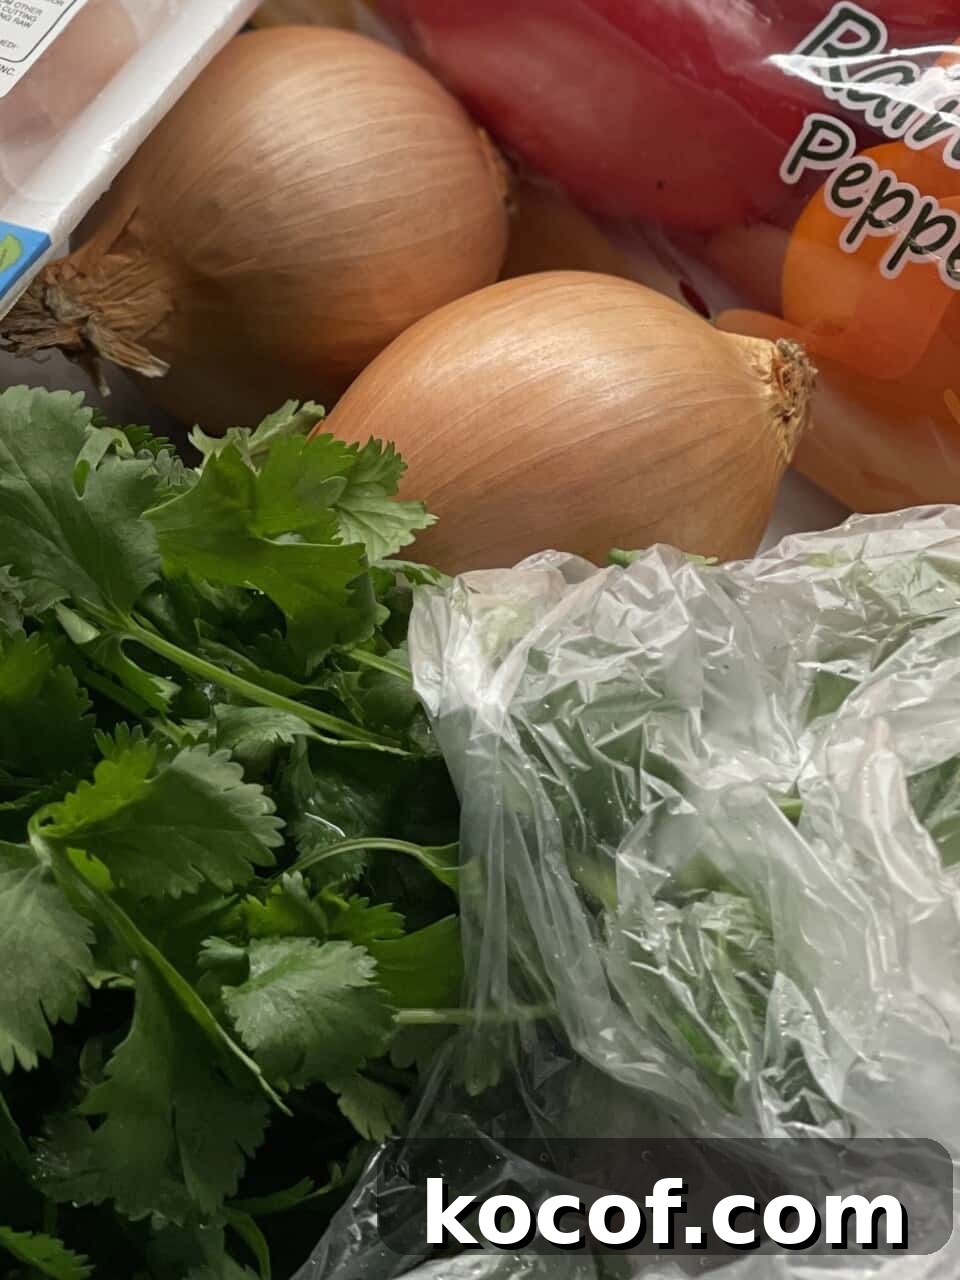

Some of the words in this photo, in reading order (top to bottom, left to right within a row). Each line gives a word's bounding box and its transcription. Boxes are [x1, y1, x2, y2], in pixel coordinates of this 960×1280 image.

[1, 5, 37, 22] CUTTING
[13, 1, 42, 15] OTHER
[12, 16, 32, 28] RAW
